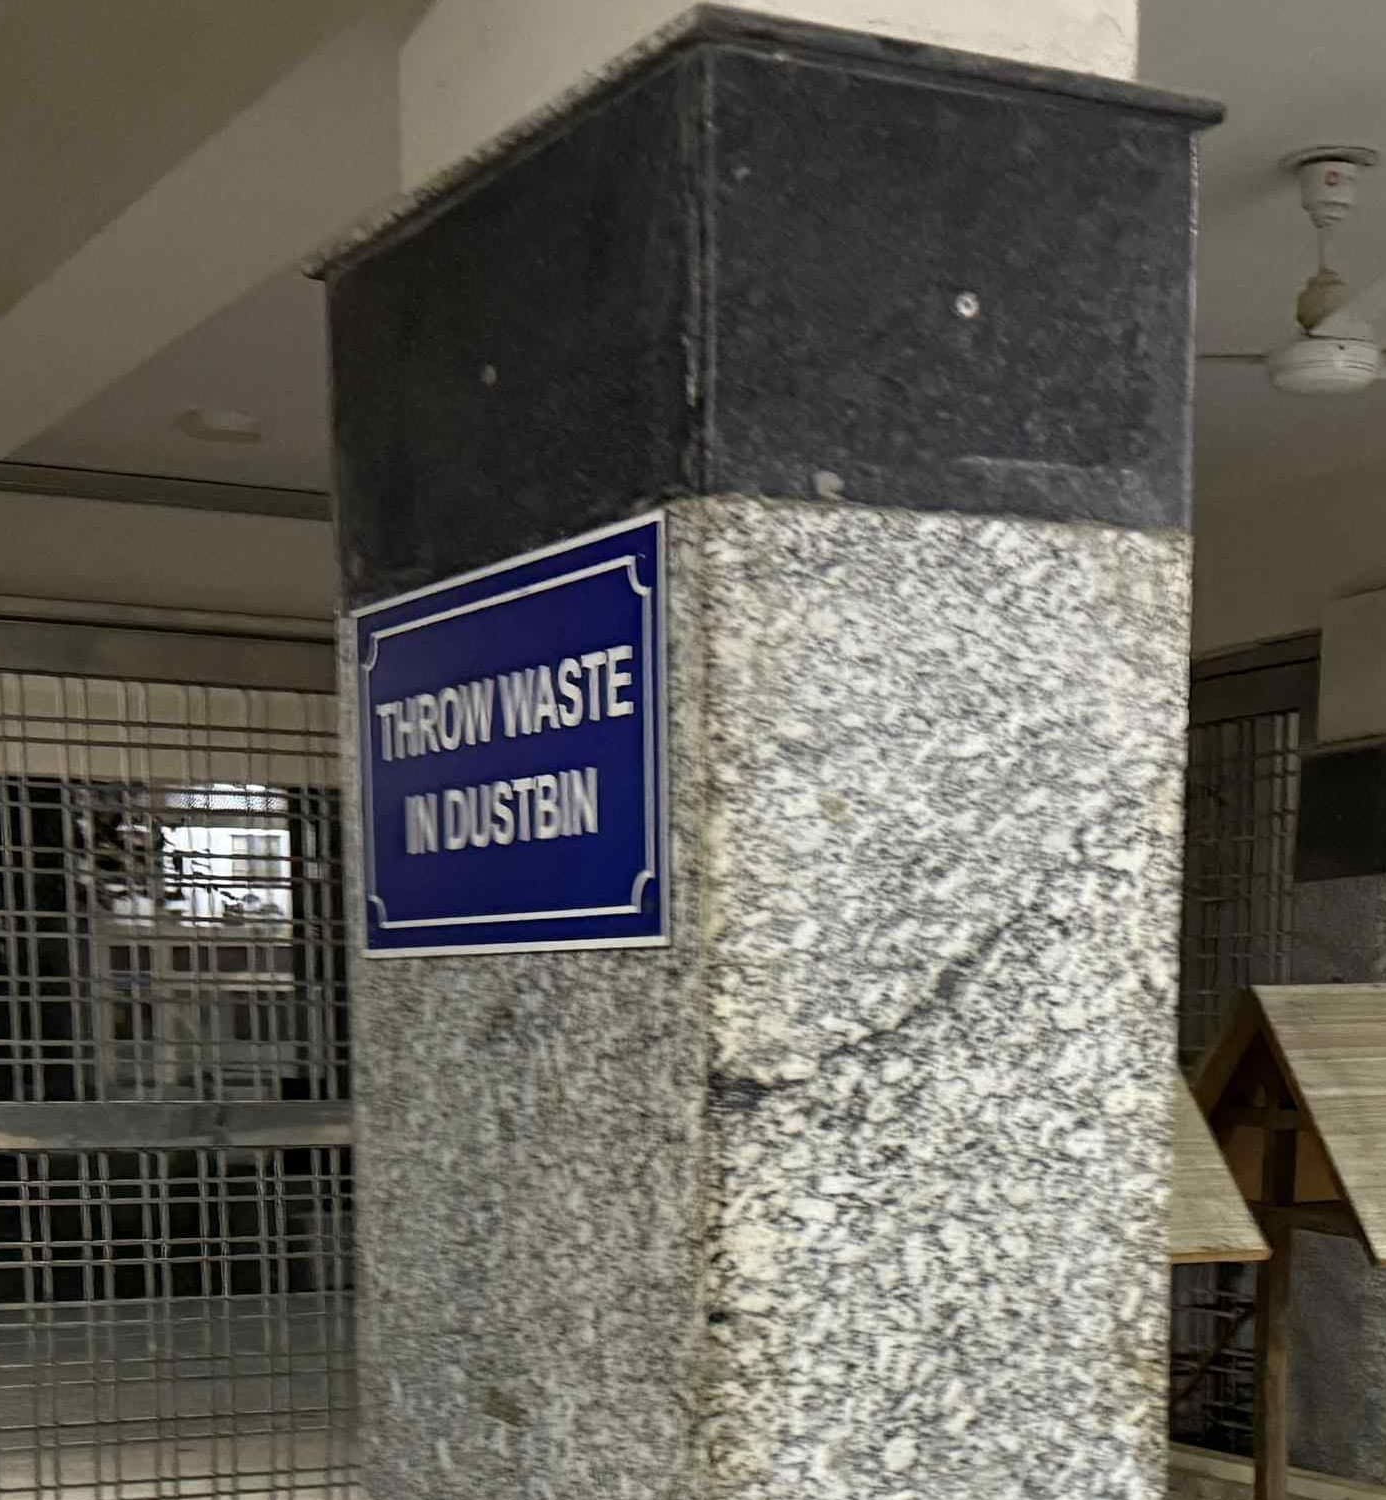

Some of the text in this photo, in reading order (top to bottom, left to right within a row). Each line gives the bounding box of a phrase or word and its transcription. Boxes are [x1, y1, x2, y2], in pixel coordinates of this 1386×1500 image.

[376, 645, 634, 761] THROW WASTE
[405, 767, 598, 855] IN DUSTBIN
